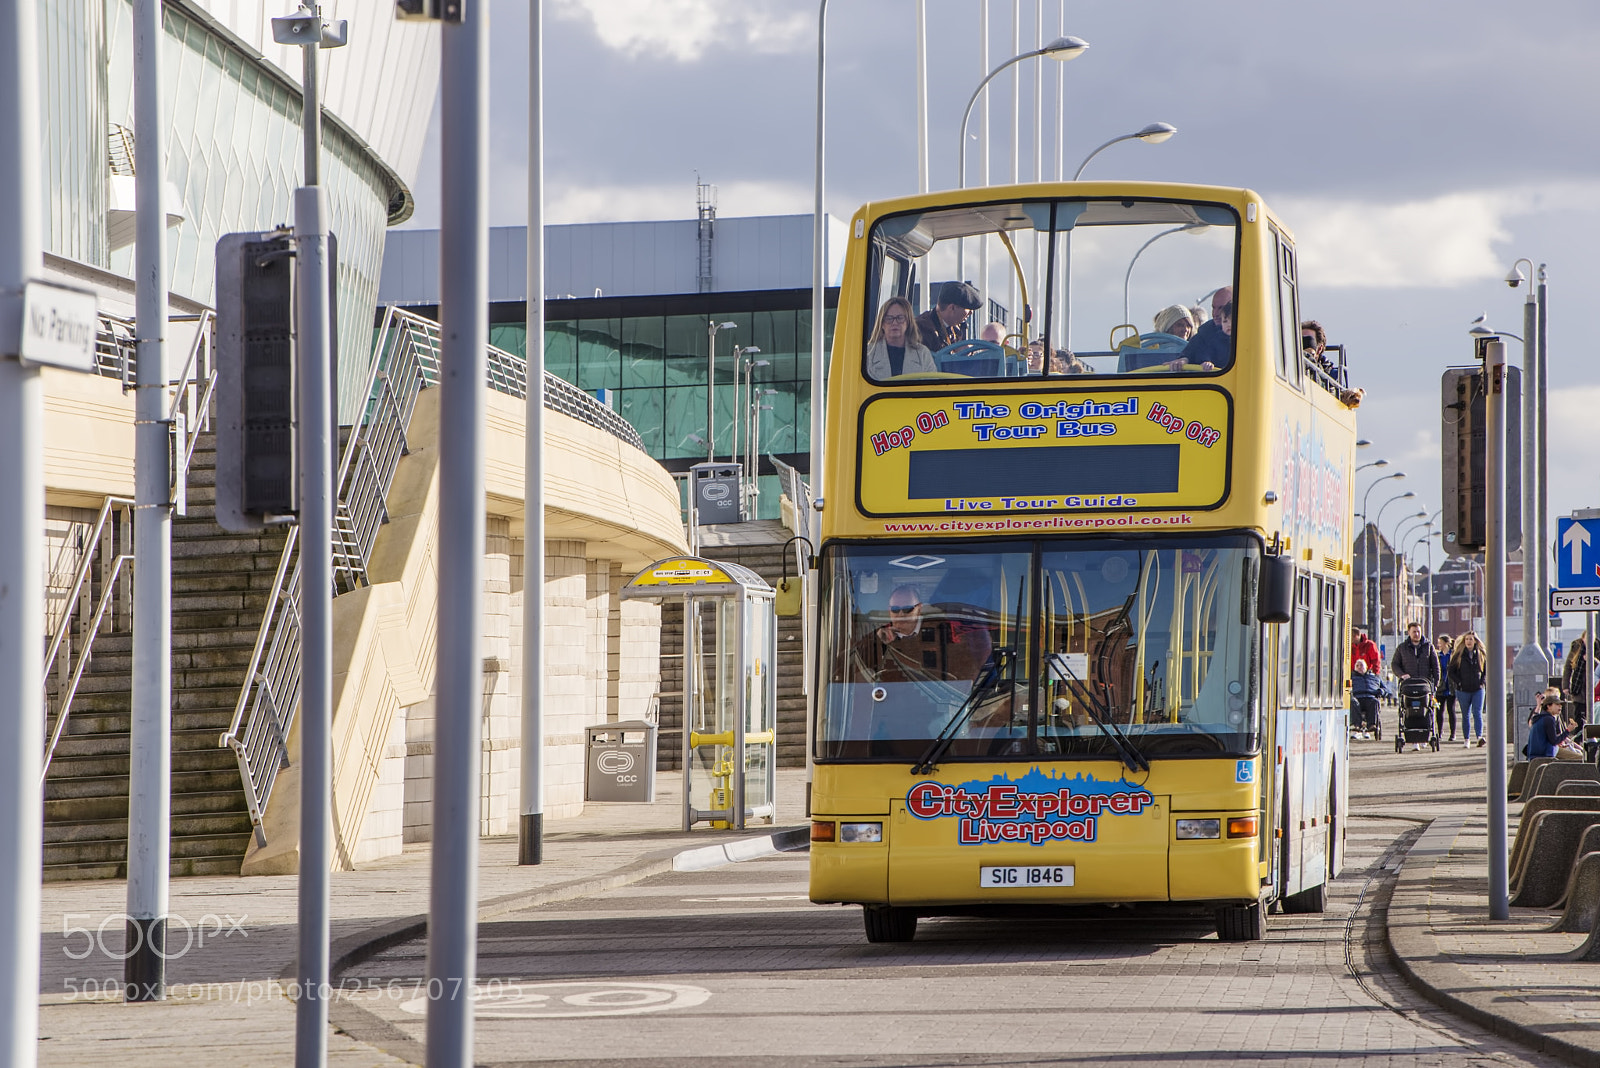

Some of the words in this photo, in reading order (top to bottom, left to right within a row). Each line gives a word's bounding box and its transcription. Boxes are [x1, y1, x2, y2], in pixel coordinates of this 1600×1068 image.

[30, 301, 45, 338] No
[49, 307, 90, 354] Parking
[953, 401, 1011, 421] The
[1019, 397, 1139, 421] Original
[871, 426, 915, 456] Hop
[915, 409, 949, 435] On
[972, 422, 1048, 442] Tour
[1056, 420, 1117, 439] Bus
[1146, 402, 1184, 435] Hop
[1185, 421, 1221, 448] Off
[944, 499, 994, 511] Live
[1001, 497, 1058, 510] Tour
[1065, 495, 1138, 508] Guide
[884, 513, 1193, 533] www.cityexplorerliverpool.co.uk
[1556, 596, 1575, 606] For
[1579, 595, 1600, 606] 135
[616, 774, 638, 783] acc
[960, 818, 1095, 845] Liverpool
[992, 868, 1018, 884] SIG
[1025, 867, 1064, 884] 1846
